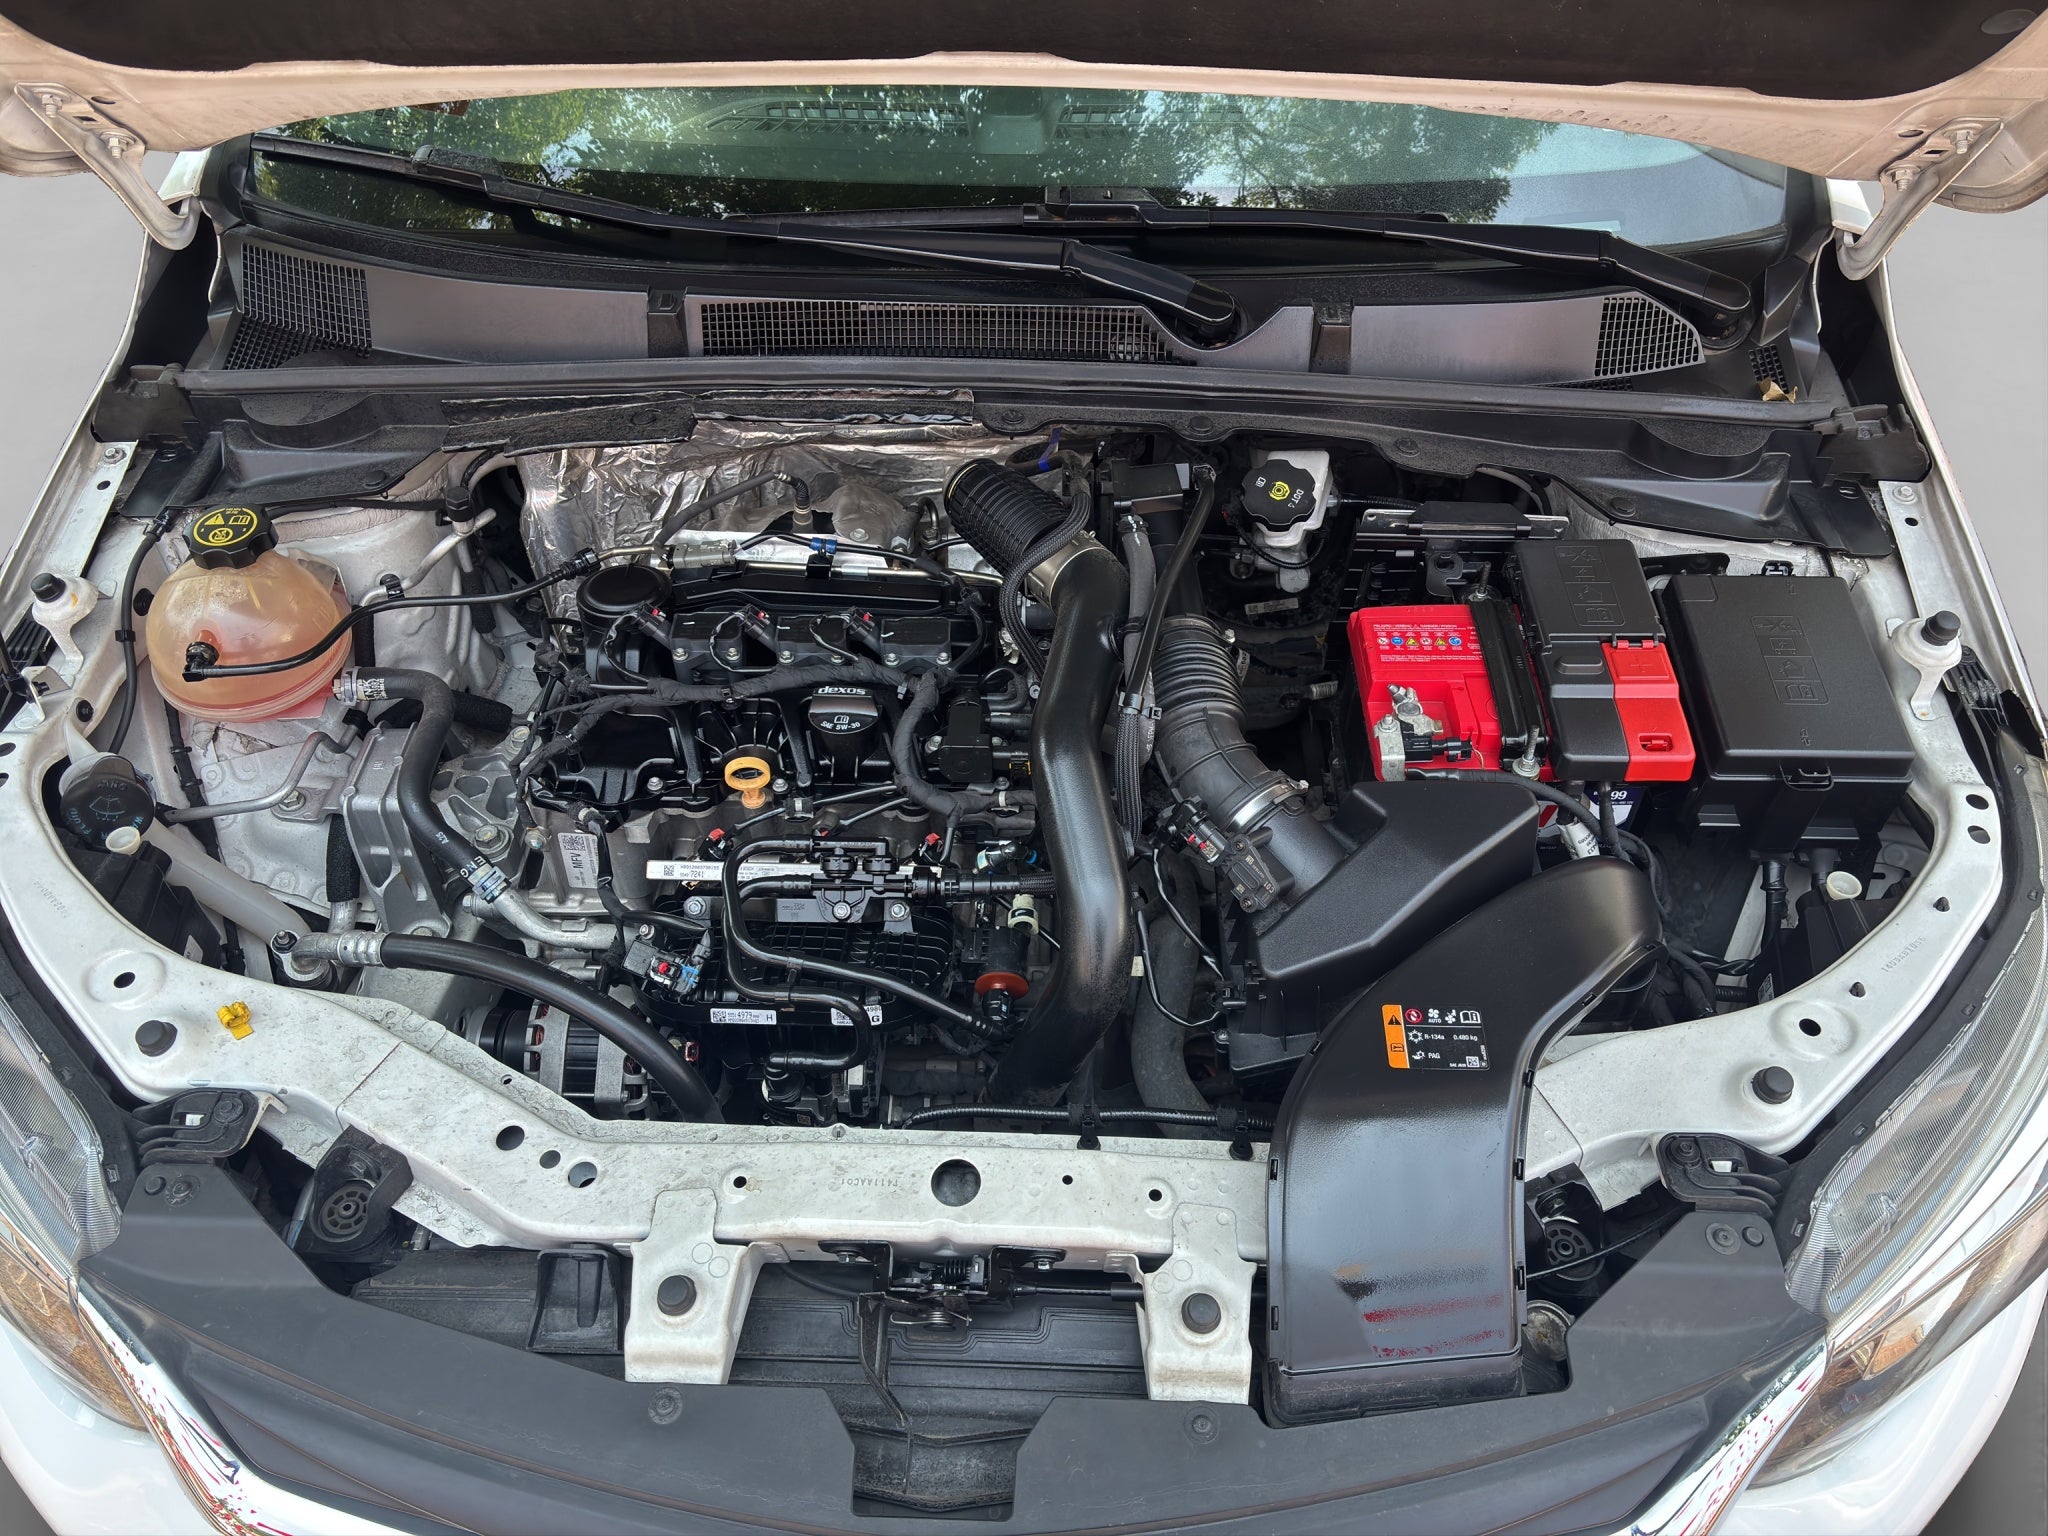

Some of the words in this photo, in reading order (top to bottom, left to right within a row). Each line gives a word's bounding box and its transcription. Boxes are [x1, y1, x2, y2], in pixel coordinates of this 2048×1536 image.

[1291, 488, 1305, 504] DOT
[818, 686, 866, 694] dexos
[820, 720, 834, 730] SAE
[836, 722, 861, 730] 5W-30
[570, 852, 584, 869] MFV
[460, 855, 487, 878] ENG
[690, 870, 704, 878] 7241
[766, 1014, 773, 1022] H
